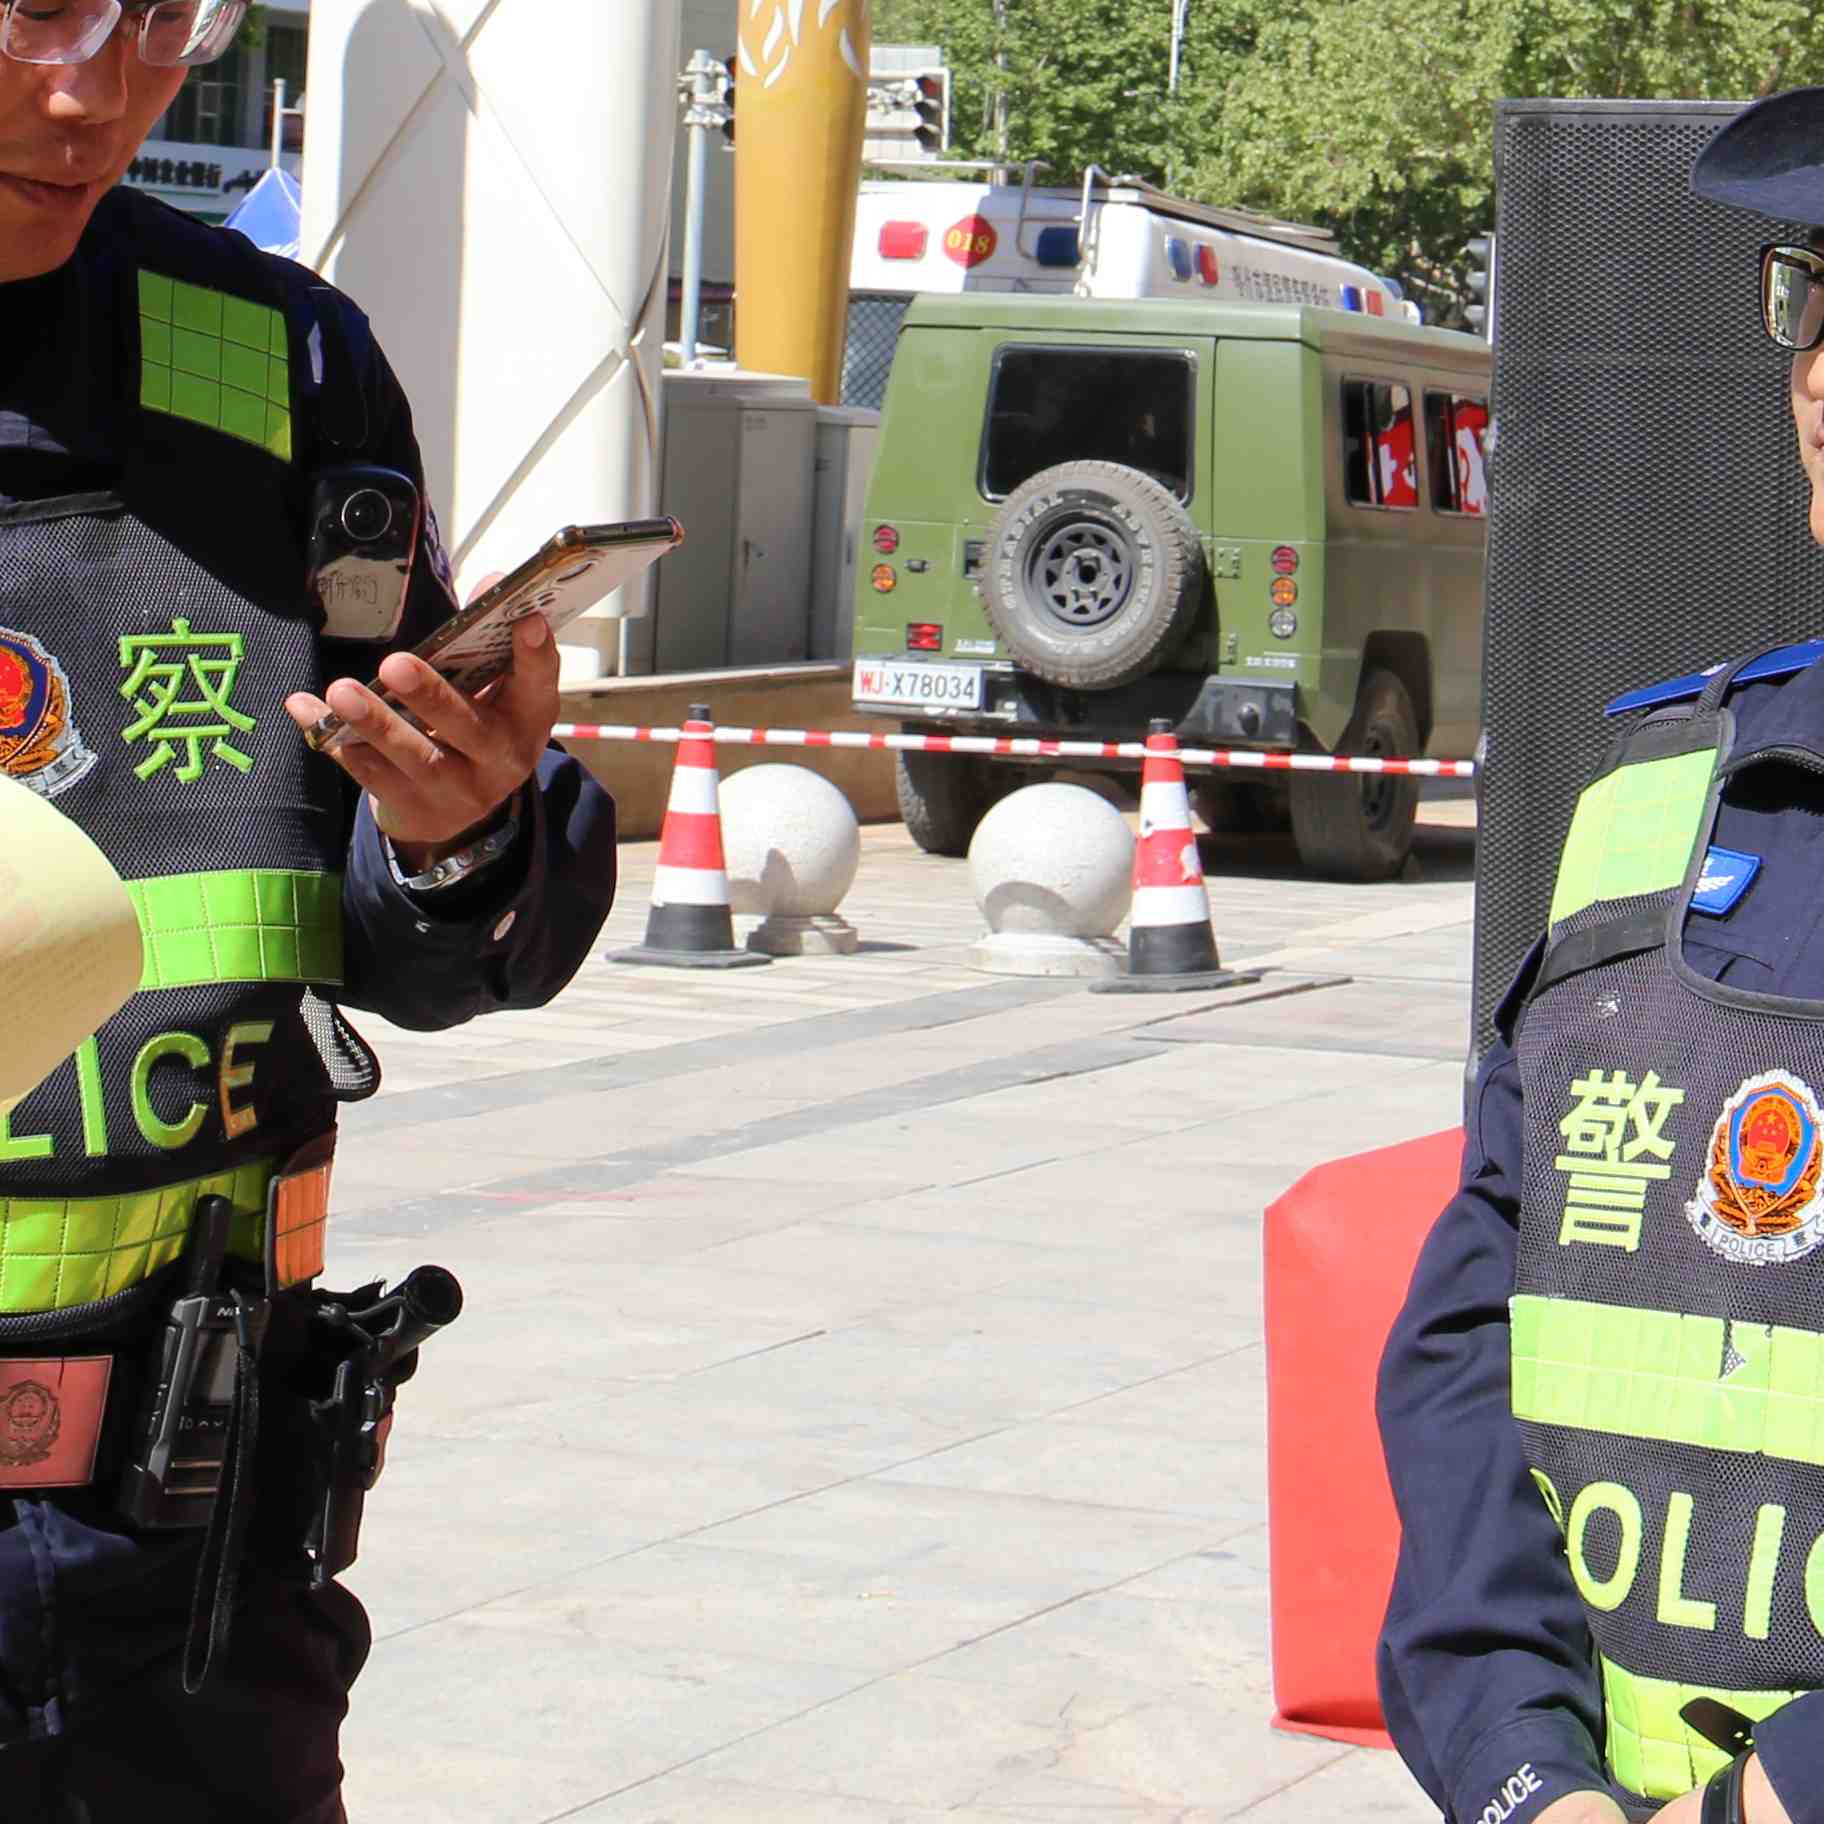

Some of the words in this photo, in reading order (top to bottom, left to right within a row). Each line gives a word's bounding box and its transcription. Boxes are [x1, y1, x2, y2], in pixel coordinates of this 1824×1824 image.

[945, 228, 989, 254] 018
[1718, 1234, 1776, 1258] POLICE
[1476, 1762, 1544, 1824] OLICE
